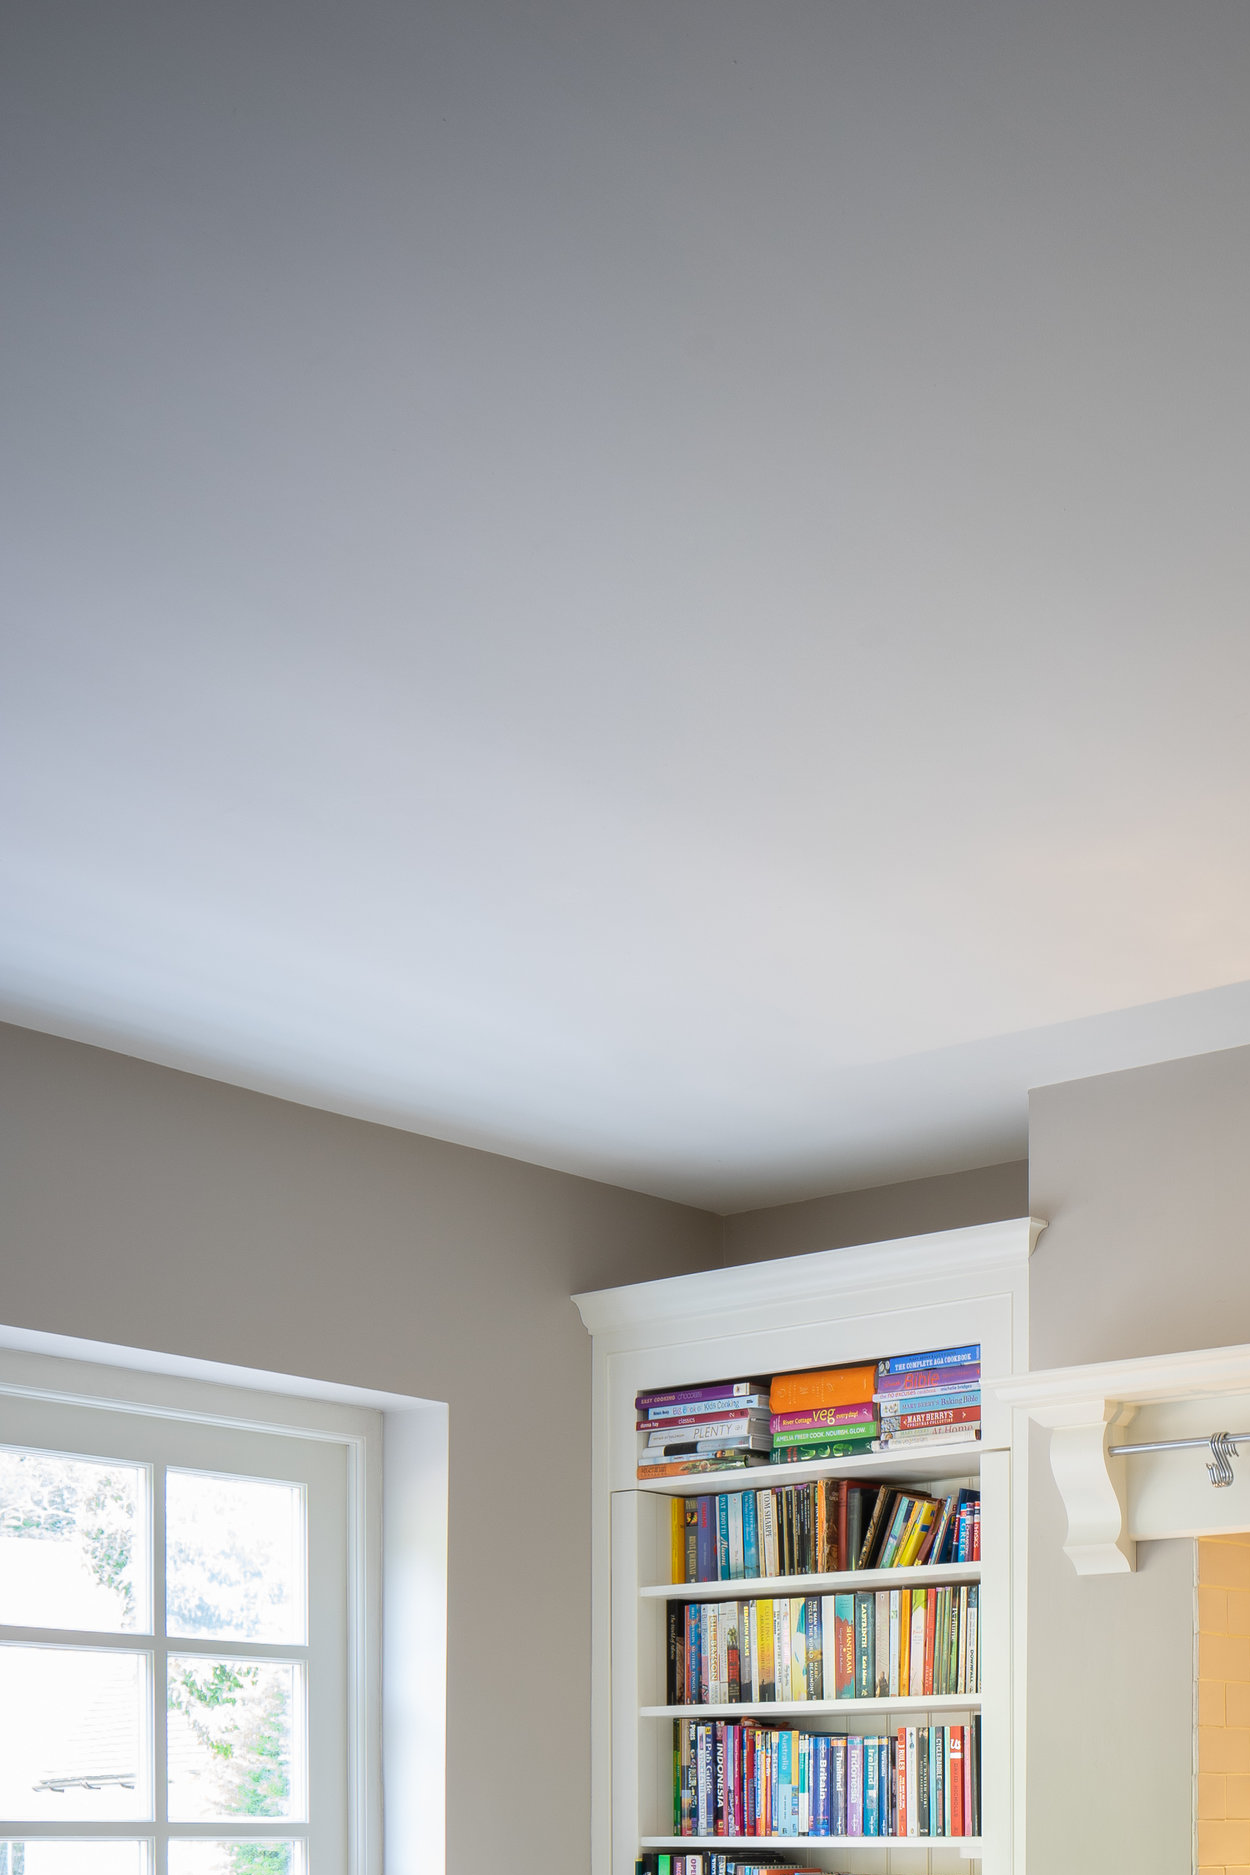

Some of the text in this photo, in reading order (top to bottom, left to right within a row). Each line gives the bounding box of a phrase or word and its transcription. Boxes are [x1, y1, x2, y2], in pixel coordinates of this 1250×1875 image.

[906, 1360, 933, 1369] COMPLETE
[944, 1353, 972, 1364] COOKBOOK
[903, 1370, 940, 1390] Bible
[794, 1417, 813, 1425] Cottage
[812, 1408, 836, 1425] veg
[907, 1410, 954, 1423] MARY BERRY'S
[693, 1424, 732, 1440] PLENTY
[775, 1434, 794, 1442] AMELIA
[763, 1492, 773, 1537] TOM SHARPE
[710, 1639, 718, 1680] BRYSON
[781, 1733, 789, 1771] Australia
[716, 1742, 724, 1808] INDONESIA
[819, 1759, 828, 1800] Britain
[850, 1749, 859, 1804] Indonesia
